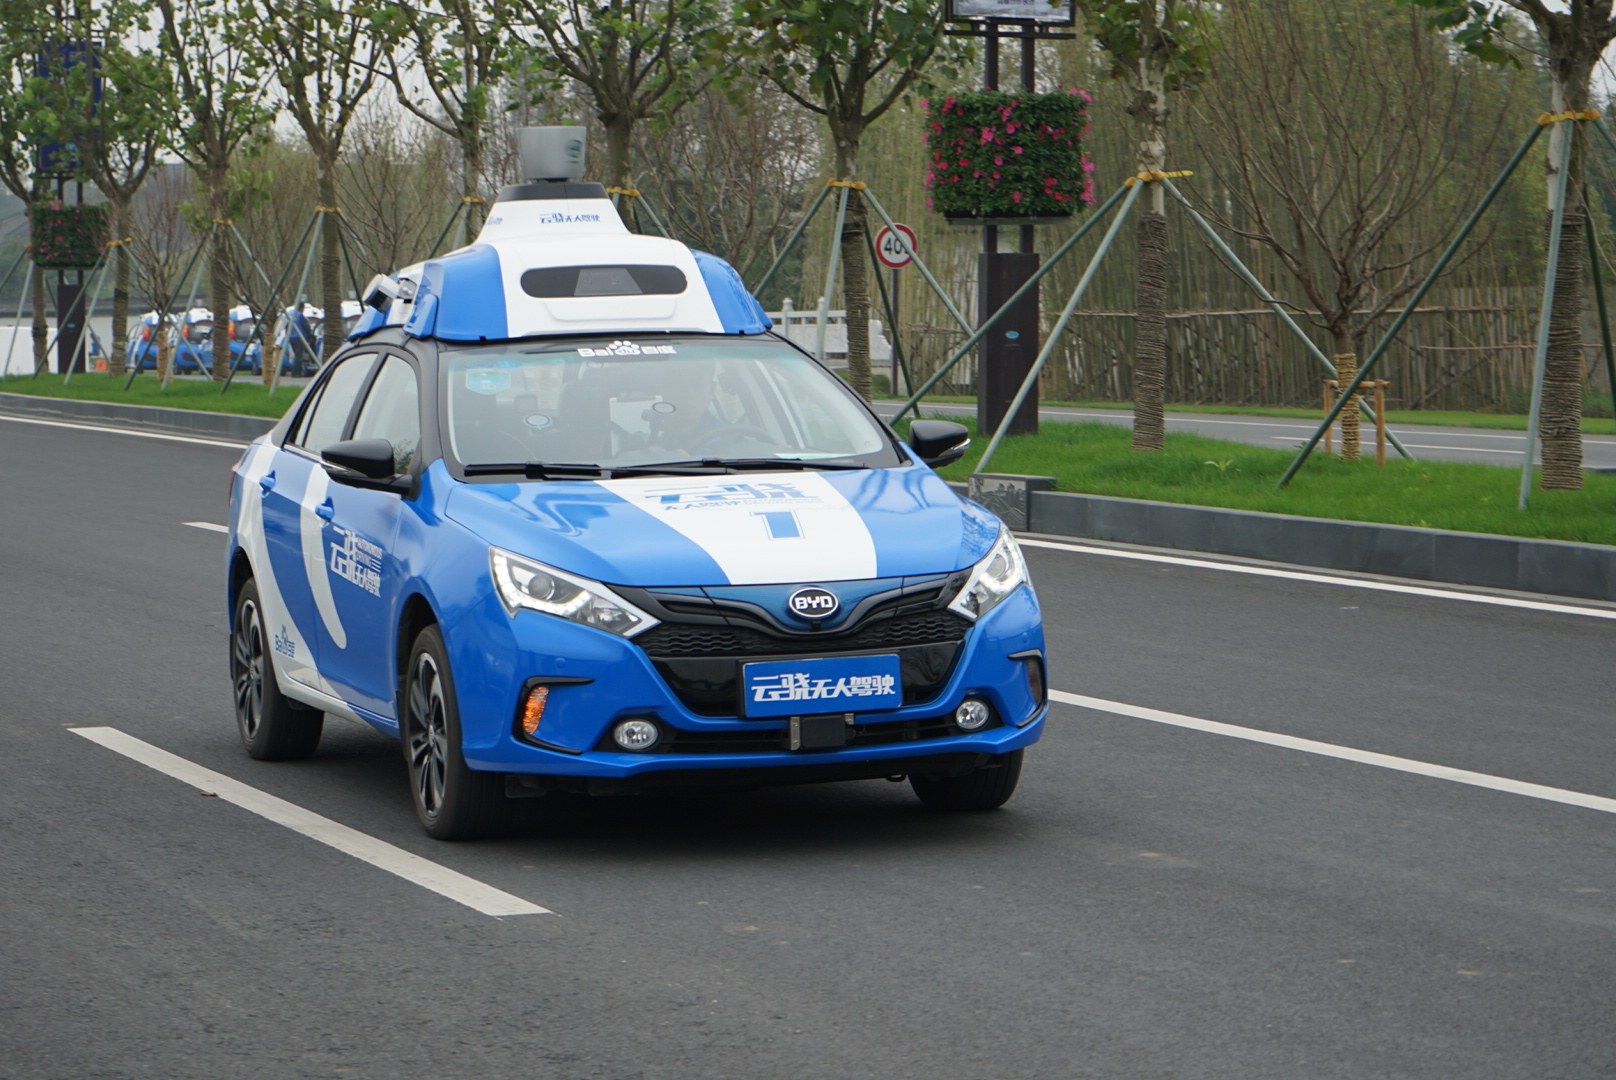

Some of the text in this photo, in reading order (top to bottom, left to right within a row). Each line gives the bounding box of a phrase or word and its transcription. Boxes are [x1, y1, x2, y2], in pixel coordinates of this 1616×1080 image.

[577, 345, 641, 357] Baidu
[794, 596, 834, 610] BYD
[751, 672, 896, 702] 云骁无人驾驶
